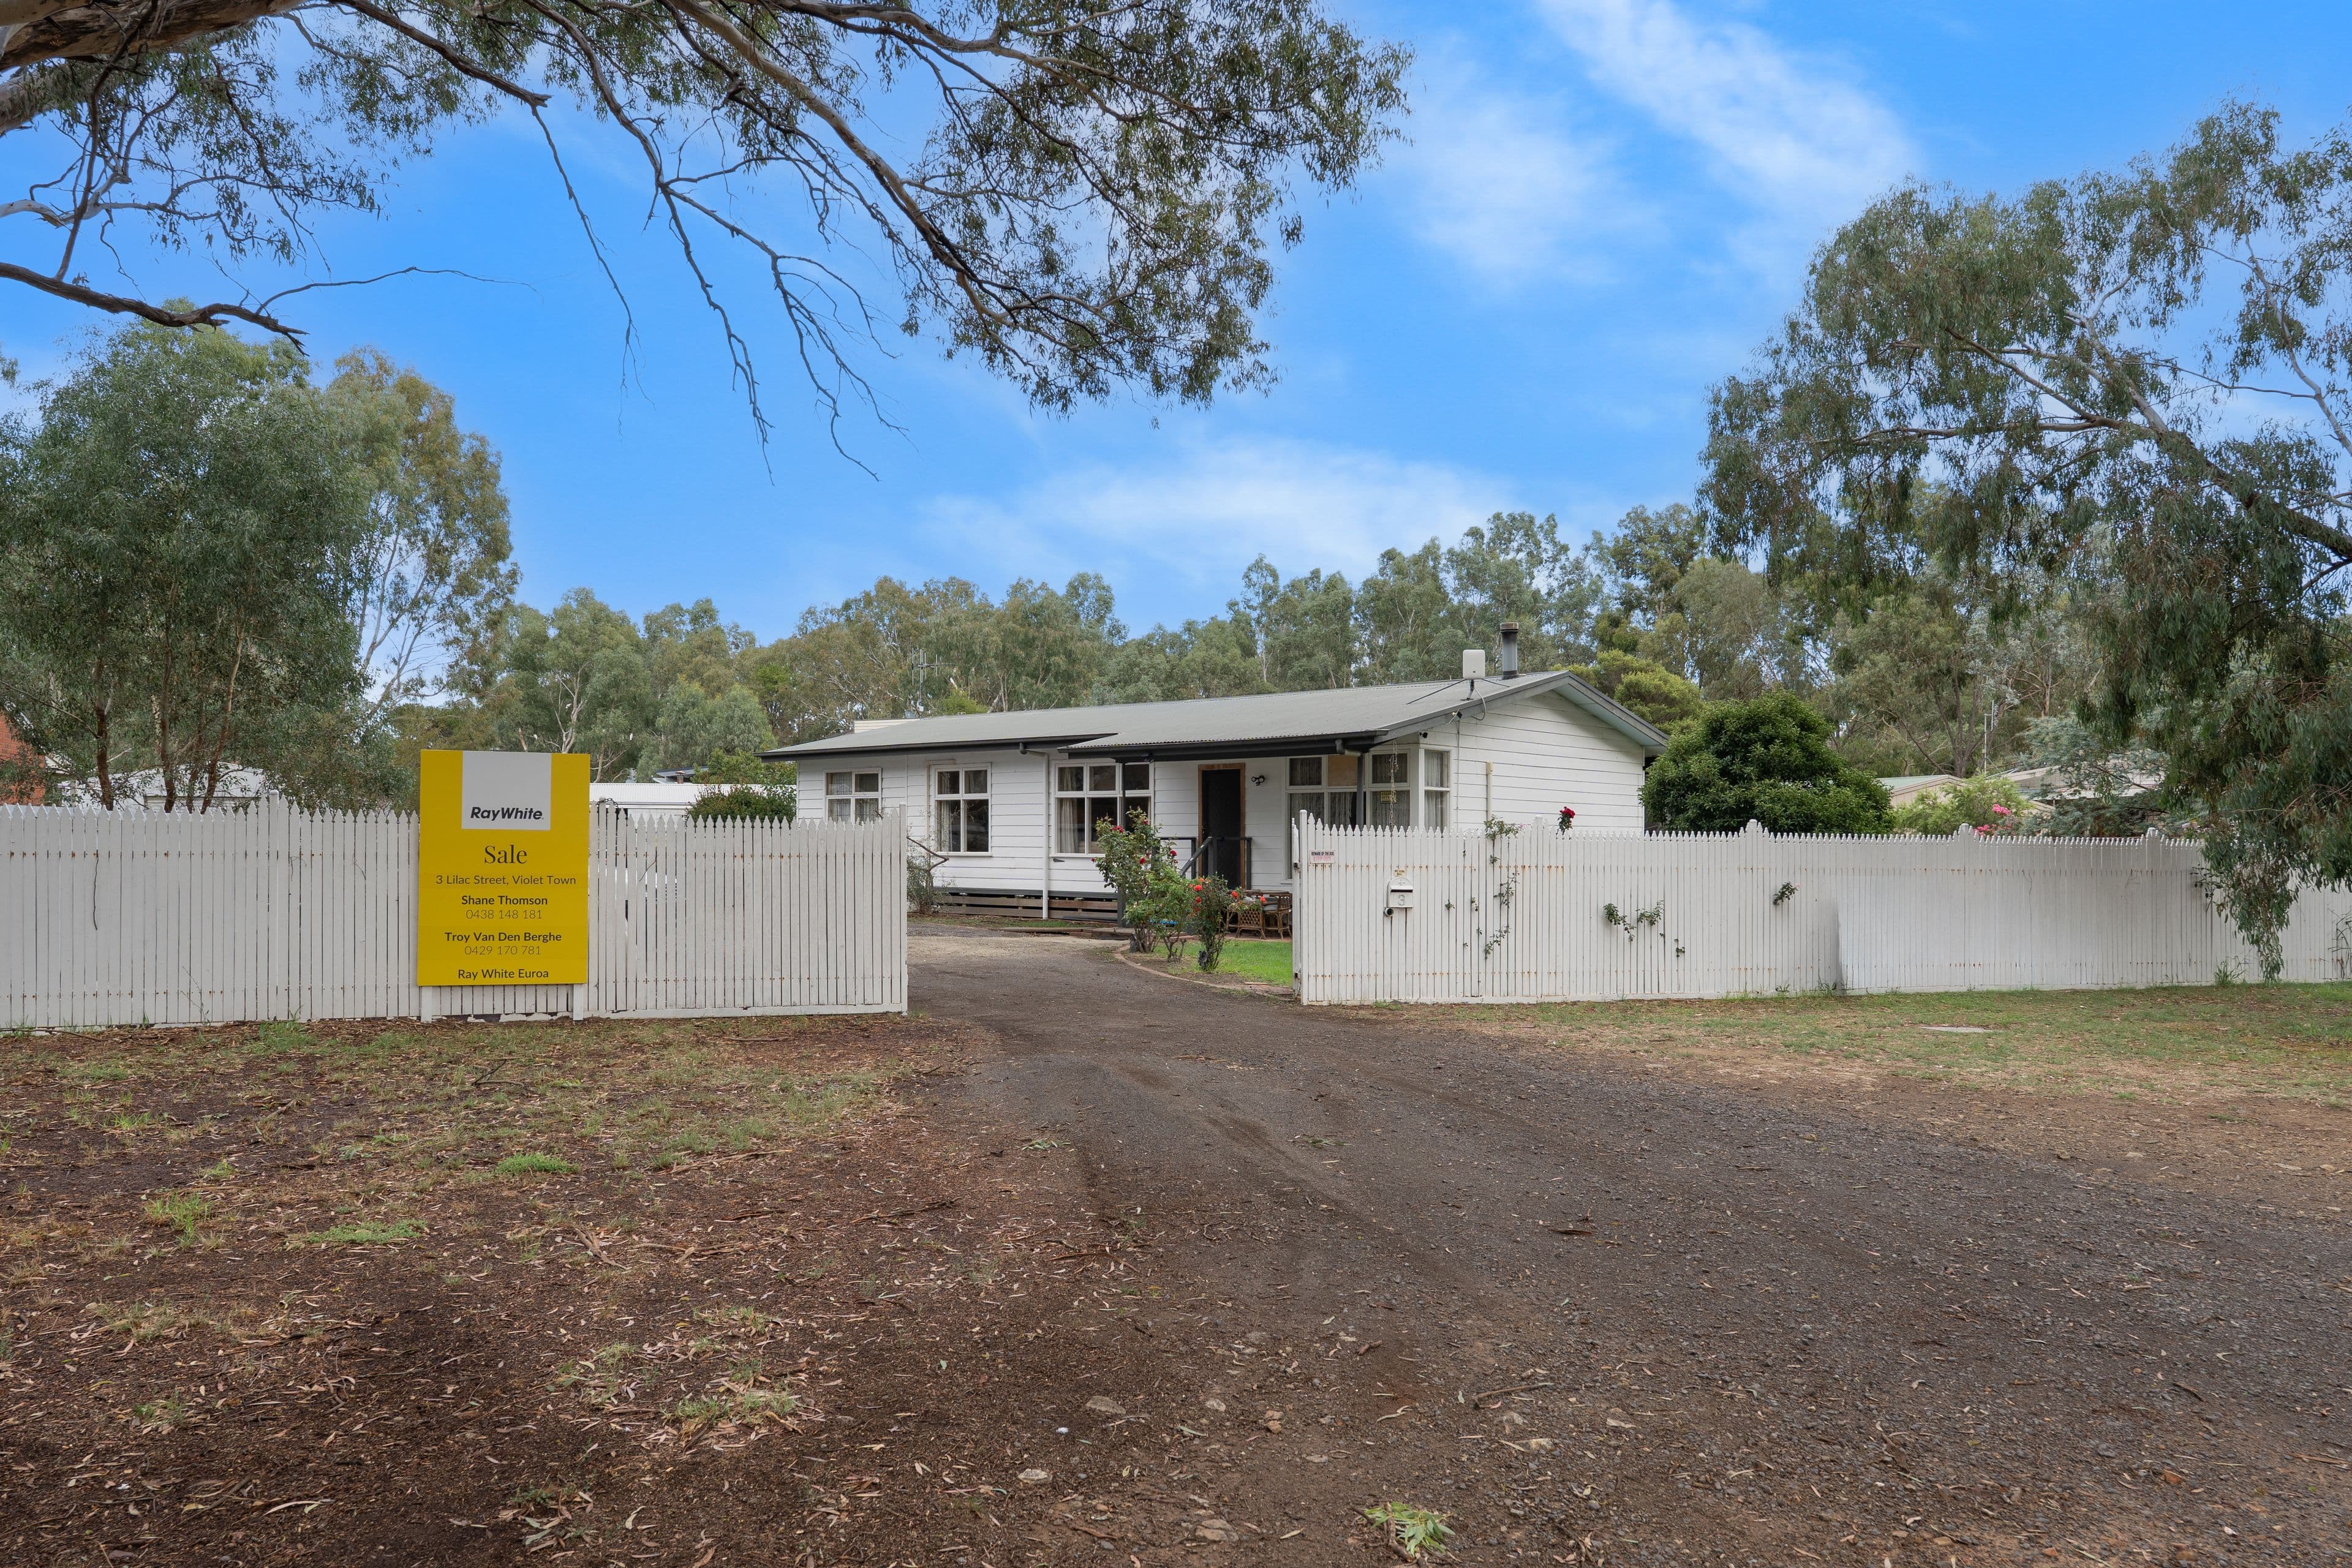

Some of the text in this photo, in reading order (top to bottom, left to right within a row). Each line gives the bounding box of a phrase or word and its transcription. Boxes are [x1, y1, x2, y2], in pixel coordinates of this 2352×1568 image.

[484, 845, 527, 864] Sale
[436, 875, 576, 886] 3 Lilac Street, Violet Town
[461, 895, 548, 905] Shane Thomson
[1398, 895, 1406, 906] 3
[466, 910, 542, 919] 0438 148 181
[445, 932, 562, 943] Troy Van Den Berghe
[464, 946, 541, 956] 0429 170 781
[458, 969, 549, 980] Ray White Euroa
